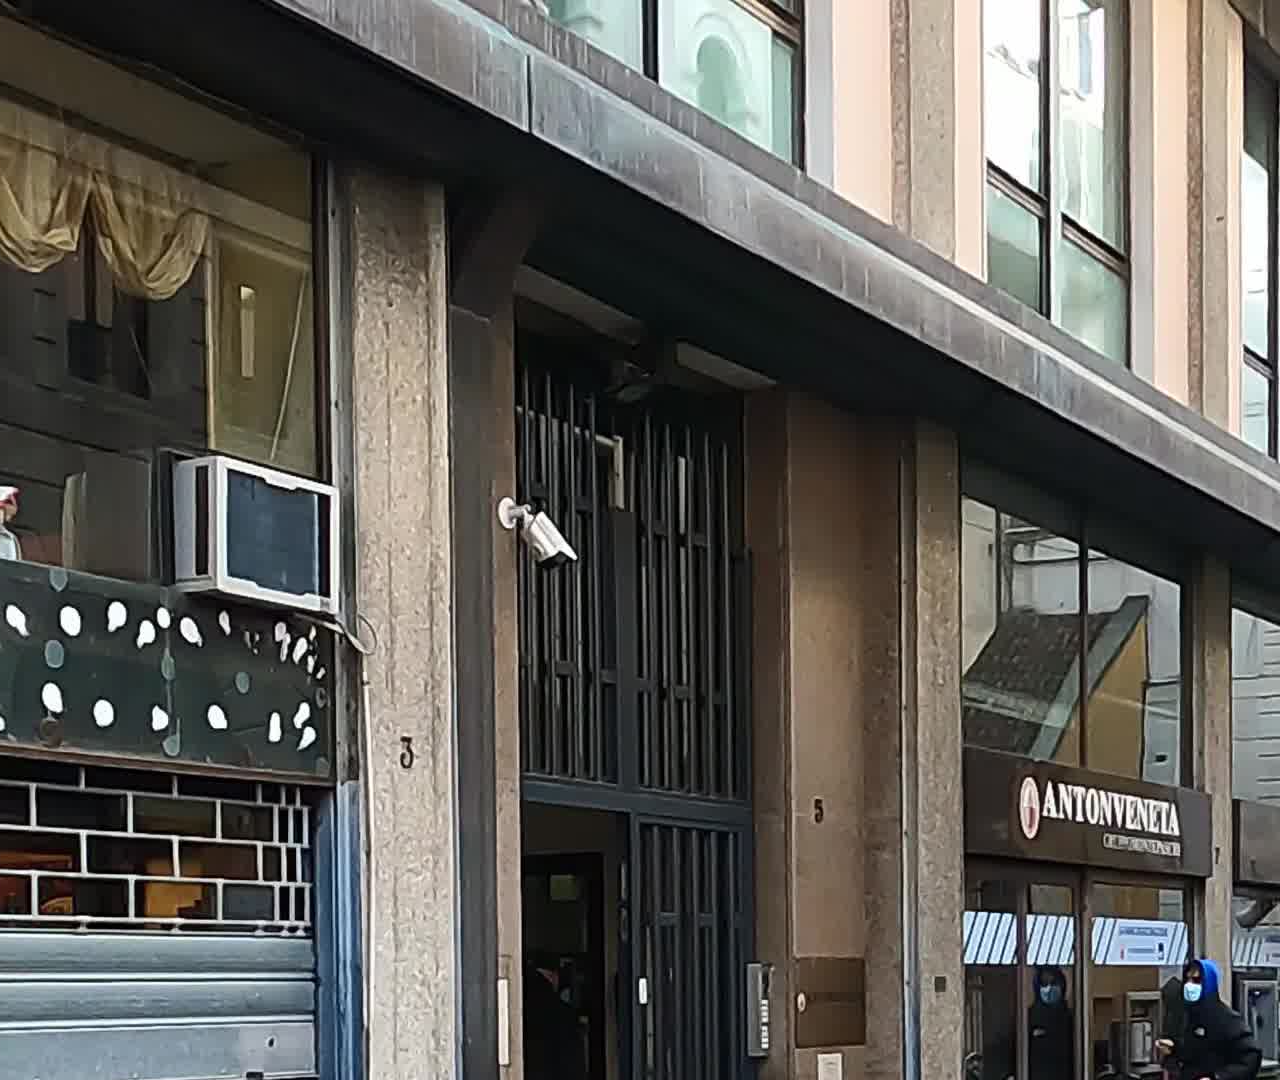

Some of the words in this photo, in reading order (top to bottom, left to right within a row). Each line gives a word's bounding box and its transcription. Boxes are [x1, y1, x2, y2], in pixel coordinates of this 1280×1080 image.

[400, 736, 414, 769] 3
[814, 798, 824, 824] 5
[1042, 780, 1180, 836] ANTONVENETA
